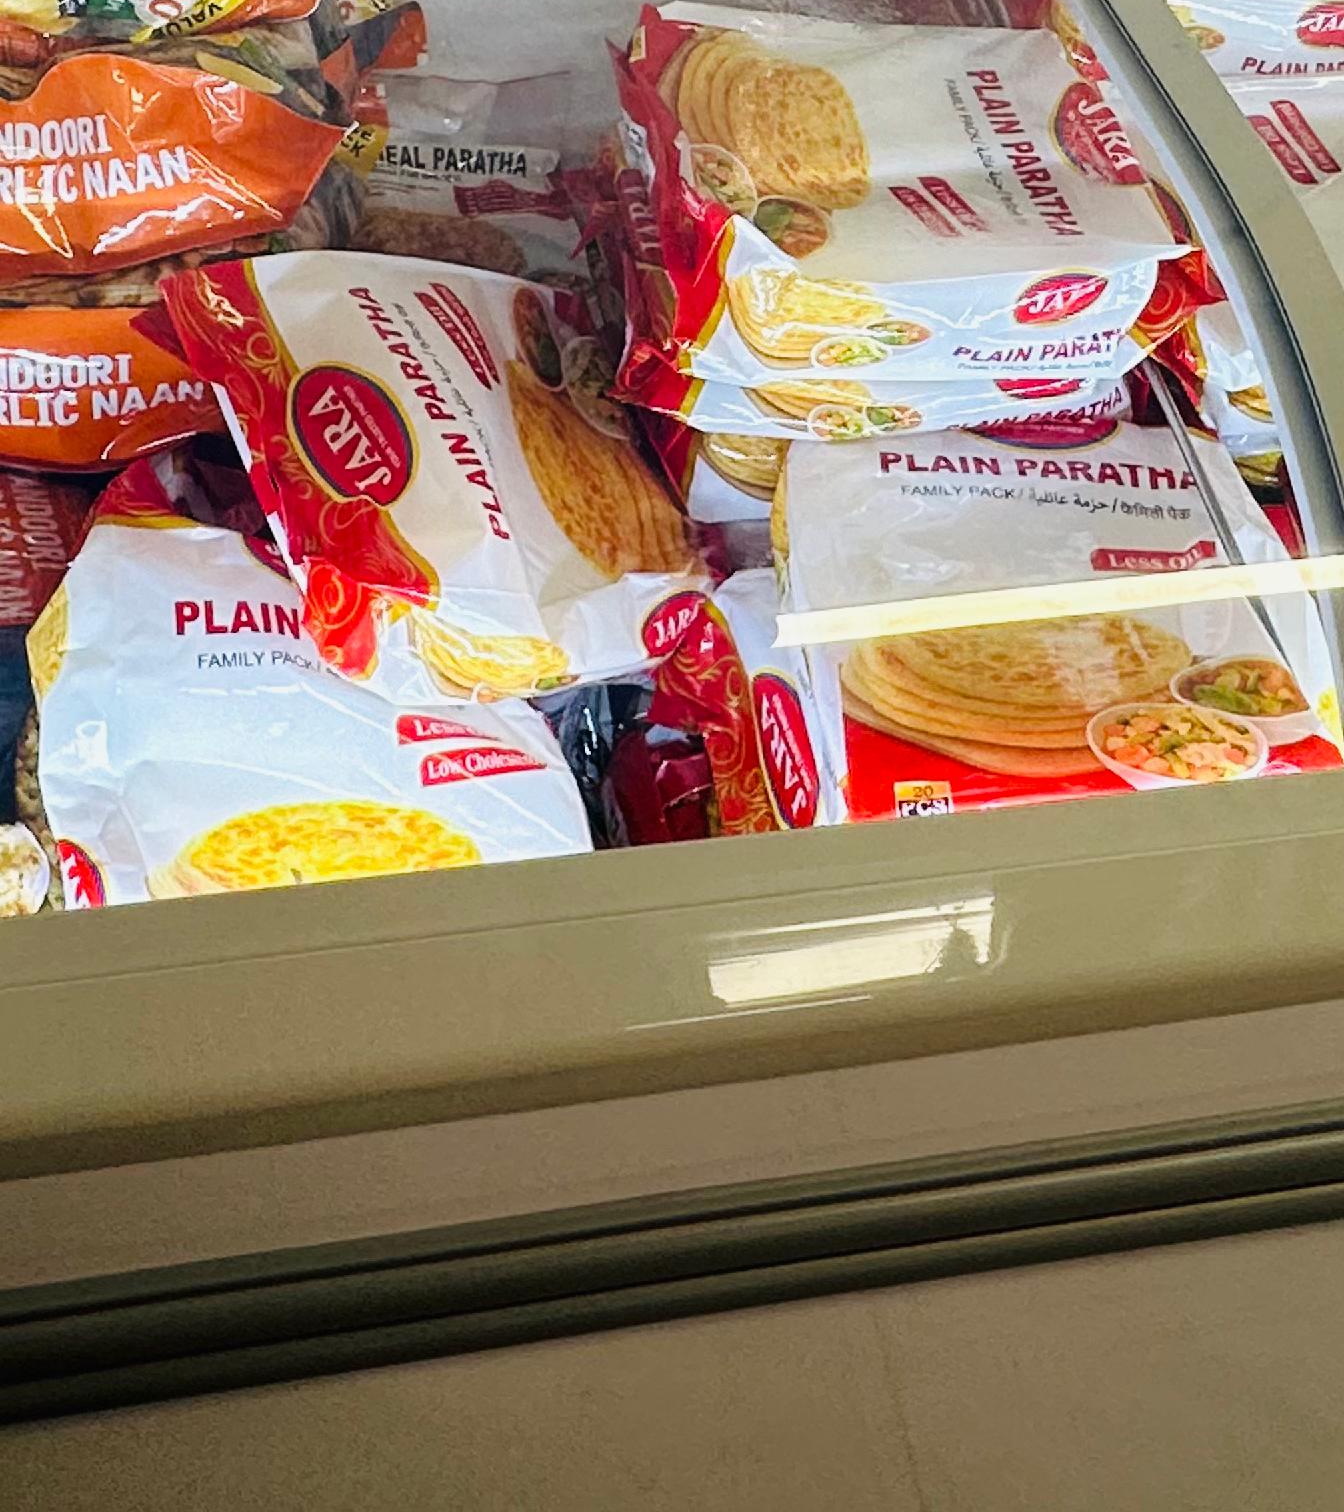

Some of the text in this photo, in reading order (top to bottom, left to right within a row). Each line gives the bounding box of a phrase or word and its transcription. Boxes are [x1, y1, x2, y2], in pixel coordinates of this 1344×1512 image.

[1241, 56, 1308, 75] PLAIN
[967, 70, 1025, 135] PLAIN
[1000, 141, 1085, 236] PARATHA
[1078, 99, 1140, 170] JARA
[83, 146, 191, 199] NAAN
[432, 144, 528, 178] PARATHA
[953, 346, 1033, 363] PLAIN
[92, 380, 205, 421] NAAN
[348, 287, 512, 541] PLAIN PARATHA
[308, 385, 393, 493] JARA
[879, 451, 1199, 491] PLAIN PARATHA
[900, 484, 962, 498] FAMILY
[11, 474, 68, 571] ANDOORI
[174, 600, 300, 640] PLAIN
[197, 651, 266, 670] FAMILY
[912, 784, 934, 798] 20
